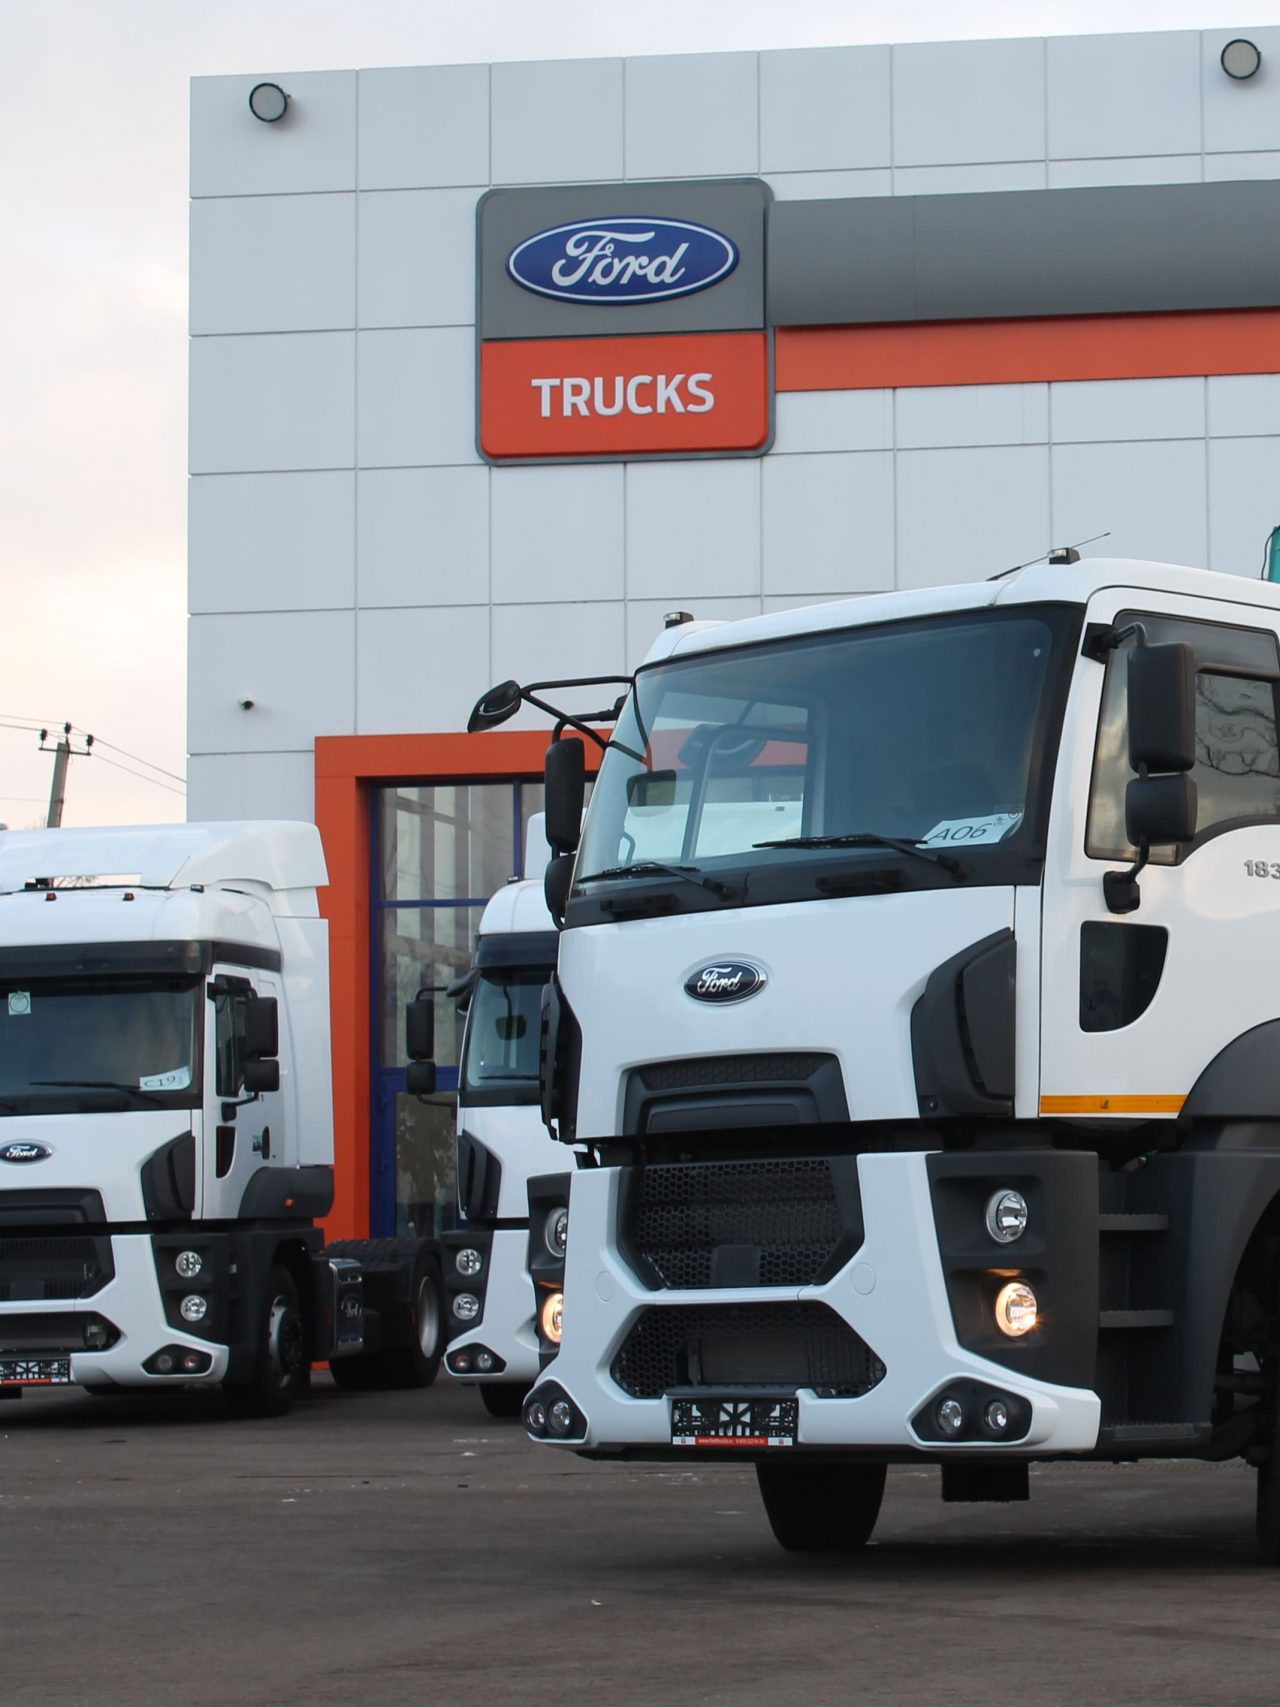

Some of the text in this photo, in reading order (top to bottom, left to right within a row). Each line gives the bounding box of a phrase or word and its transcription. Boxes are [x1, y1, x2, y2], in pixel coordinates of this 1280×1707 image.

[552, 230, 690, 286] Ford
[531, 373, 714, 417] TRUCKS
[926, 822, 993, 841] A06
[697, 967, 743, 993] Ford
[6, 1145, 39, 1159] Ford
